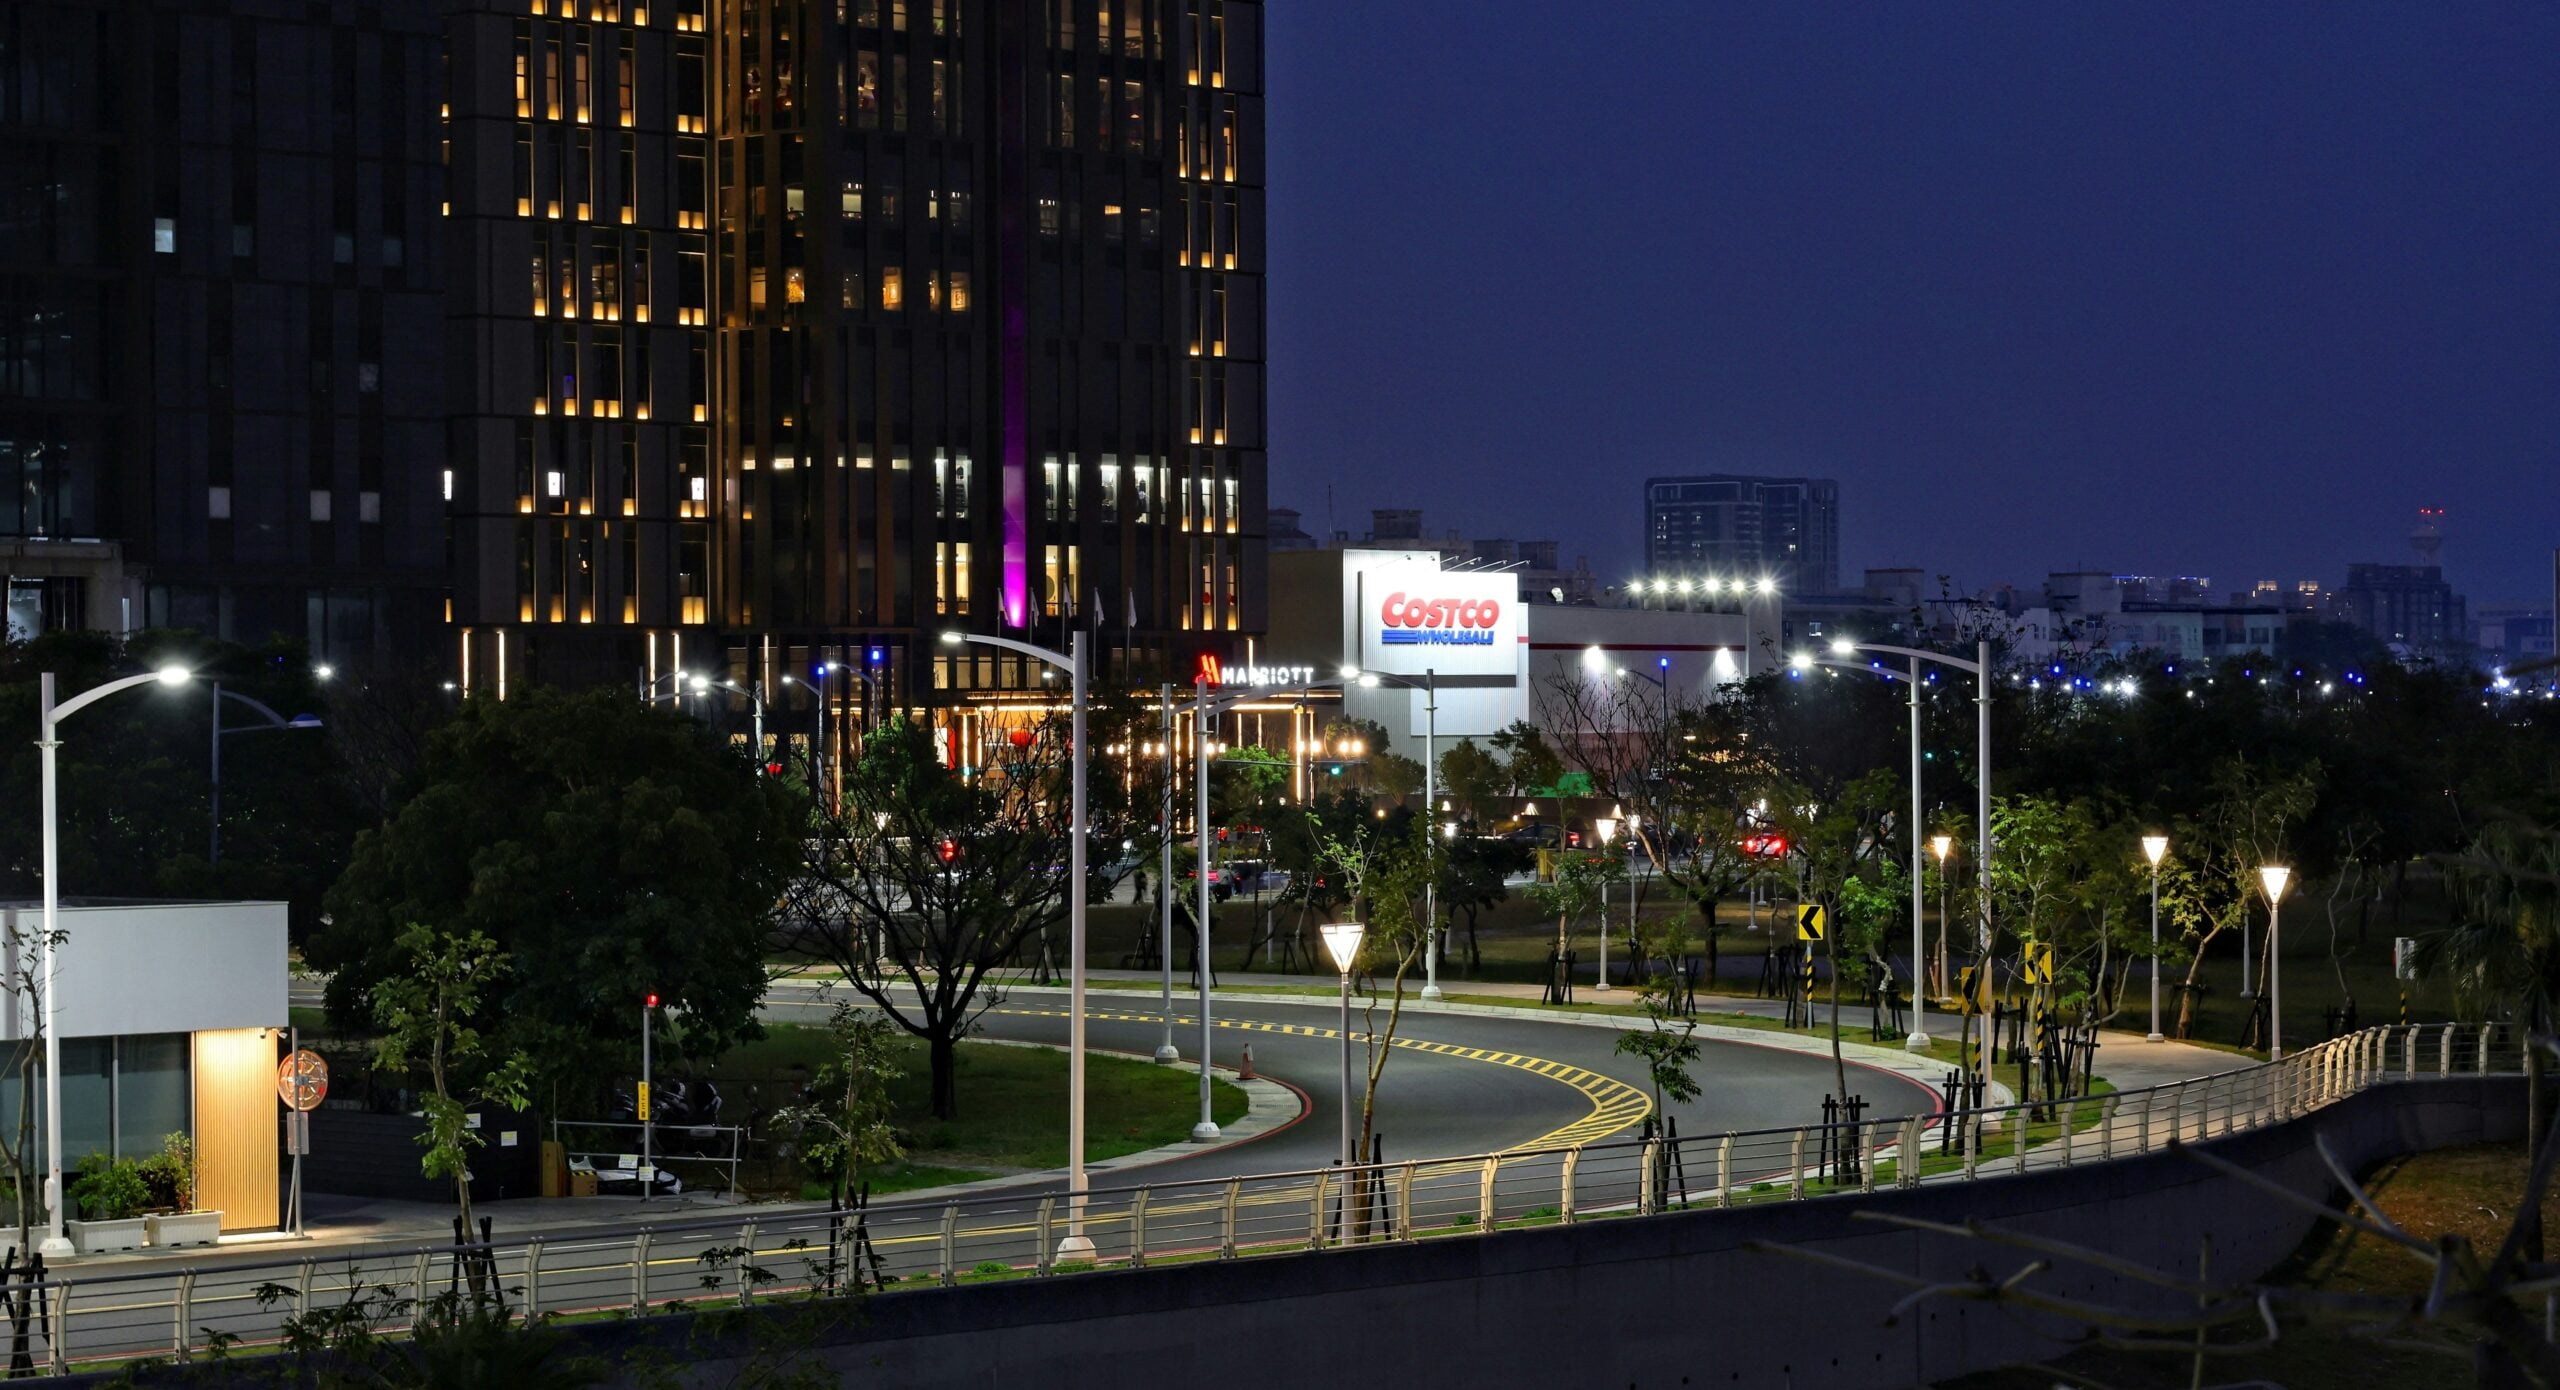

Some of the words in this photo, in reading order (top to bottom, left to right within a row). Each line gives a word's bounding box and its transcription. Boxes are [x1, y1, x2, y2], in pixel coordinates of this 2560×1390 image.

[1382, 592, 1499, 628] COSTCO
[1417, 630, 1494, 645] WHOLESALE
[1221, 667, 1314, 686] MARRIOTT
